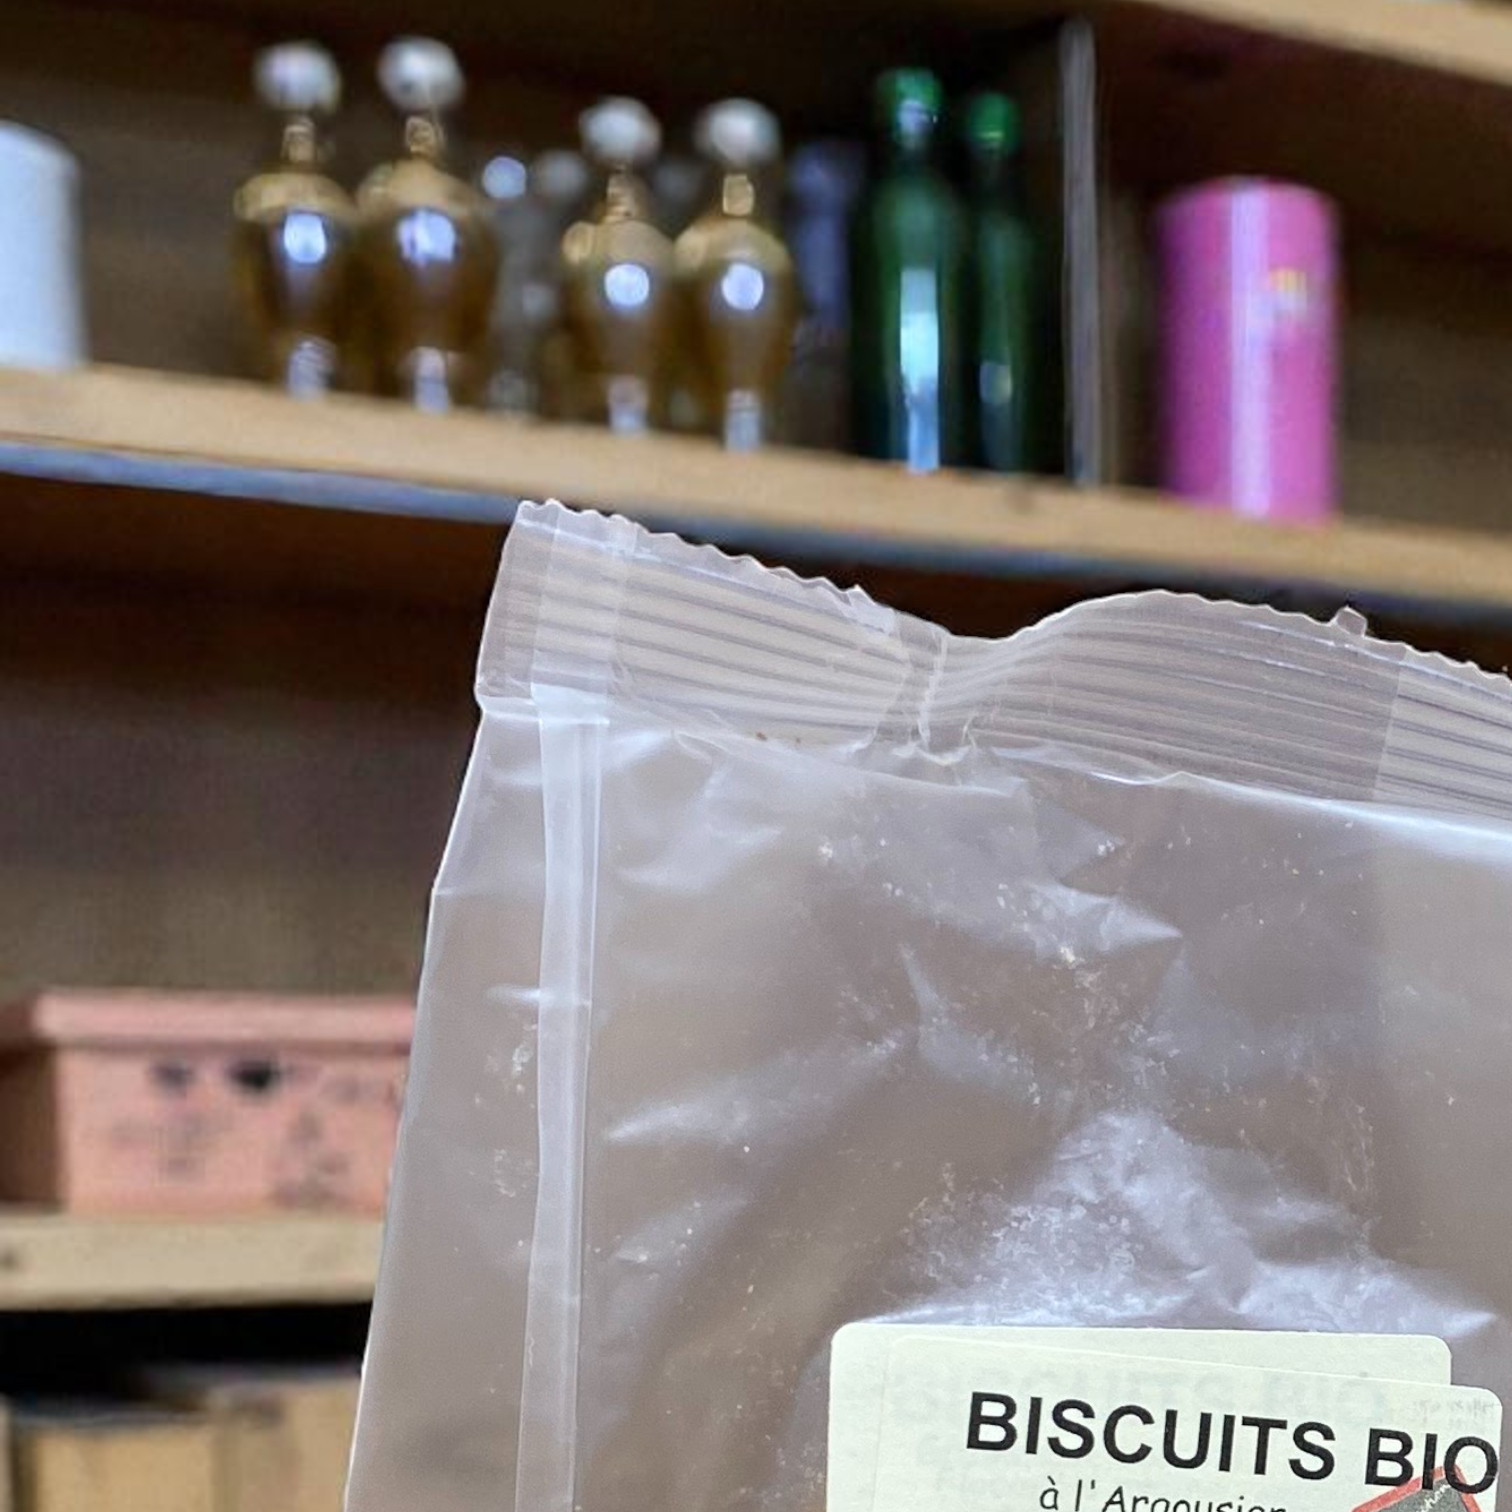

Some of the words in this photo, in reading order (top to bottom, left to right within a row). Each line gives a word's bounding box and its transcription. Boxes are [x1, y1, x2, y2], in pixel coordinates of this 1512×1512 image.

[966, 1391, 1336, 1481] BISCUITS
[1365, 1428, 1499, 1495] BIO
[1040, 1476, 1059, 1511] à
